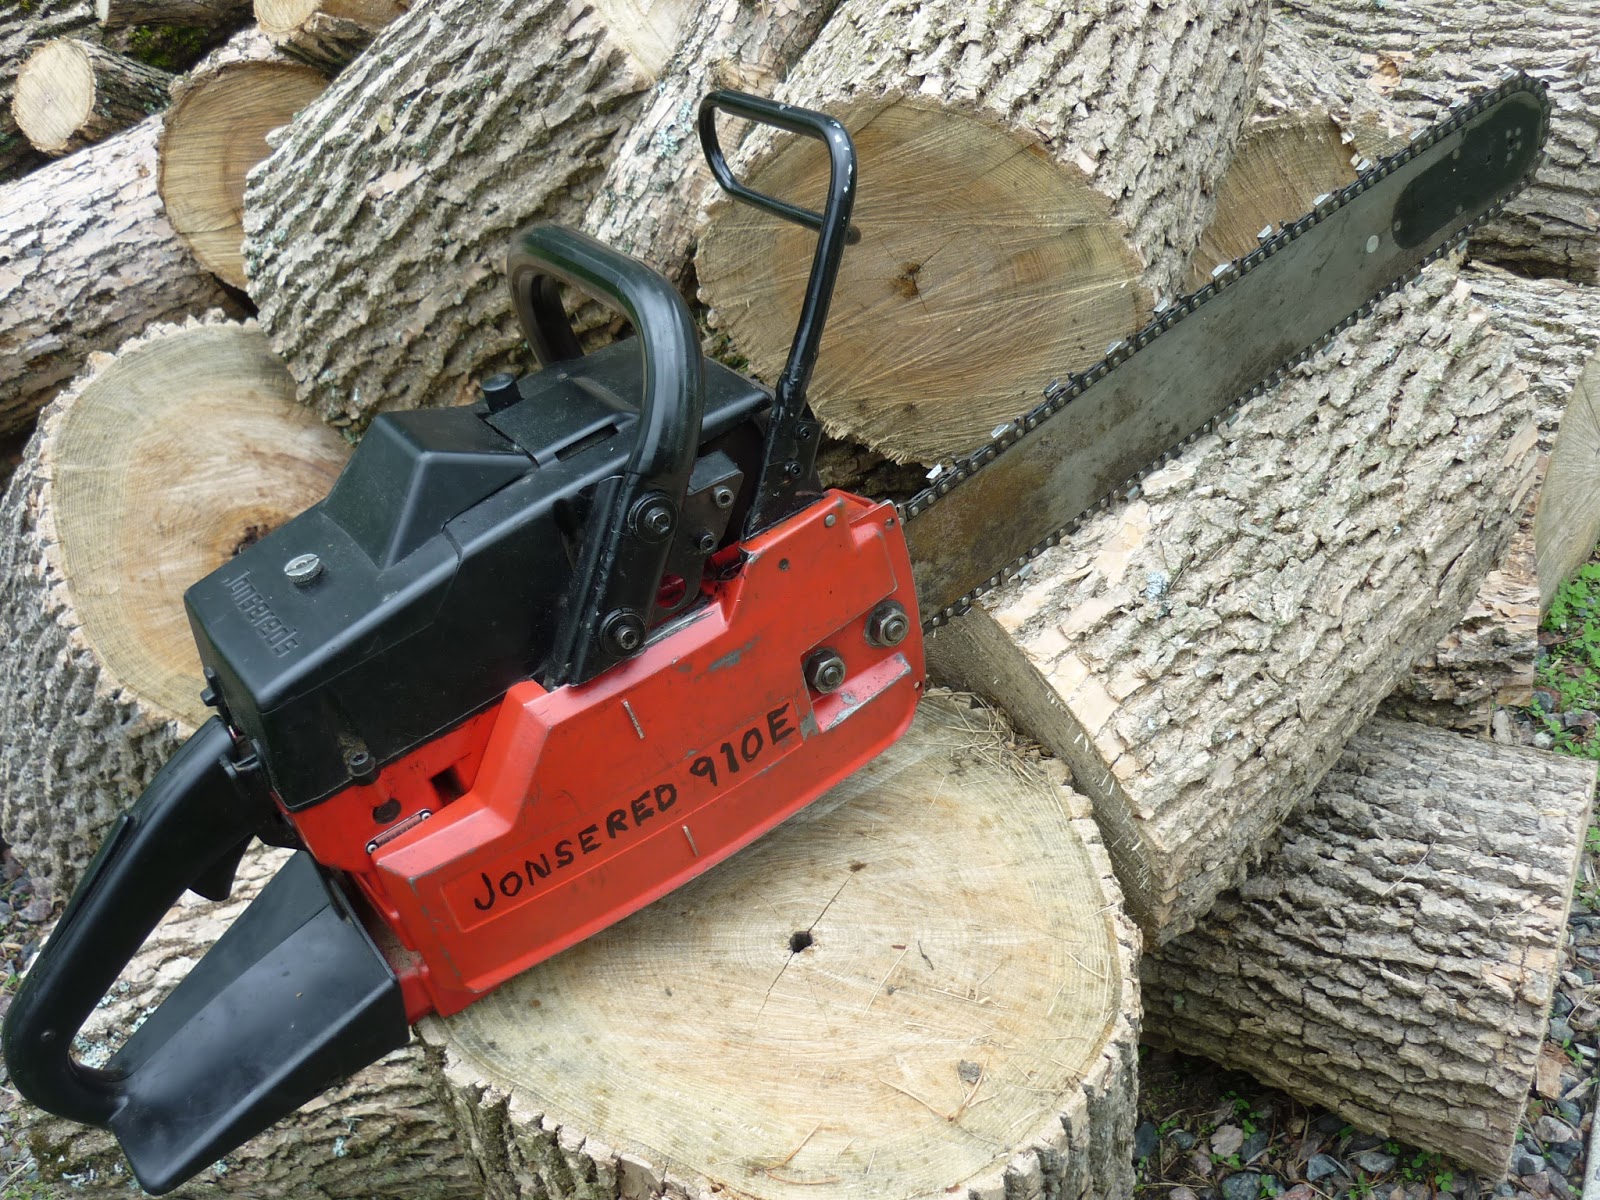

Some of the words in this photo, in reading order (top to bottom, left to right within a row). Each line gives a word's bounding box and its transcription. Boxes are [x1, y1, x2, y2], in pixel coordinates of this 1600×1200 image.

[221, 567, 299, 658] Jonsereds
[473, 783, 678, 911] JONSERED
[689, 702, 796, 786] 910E
